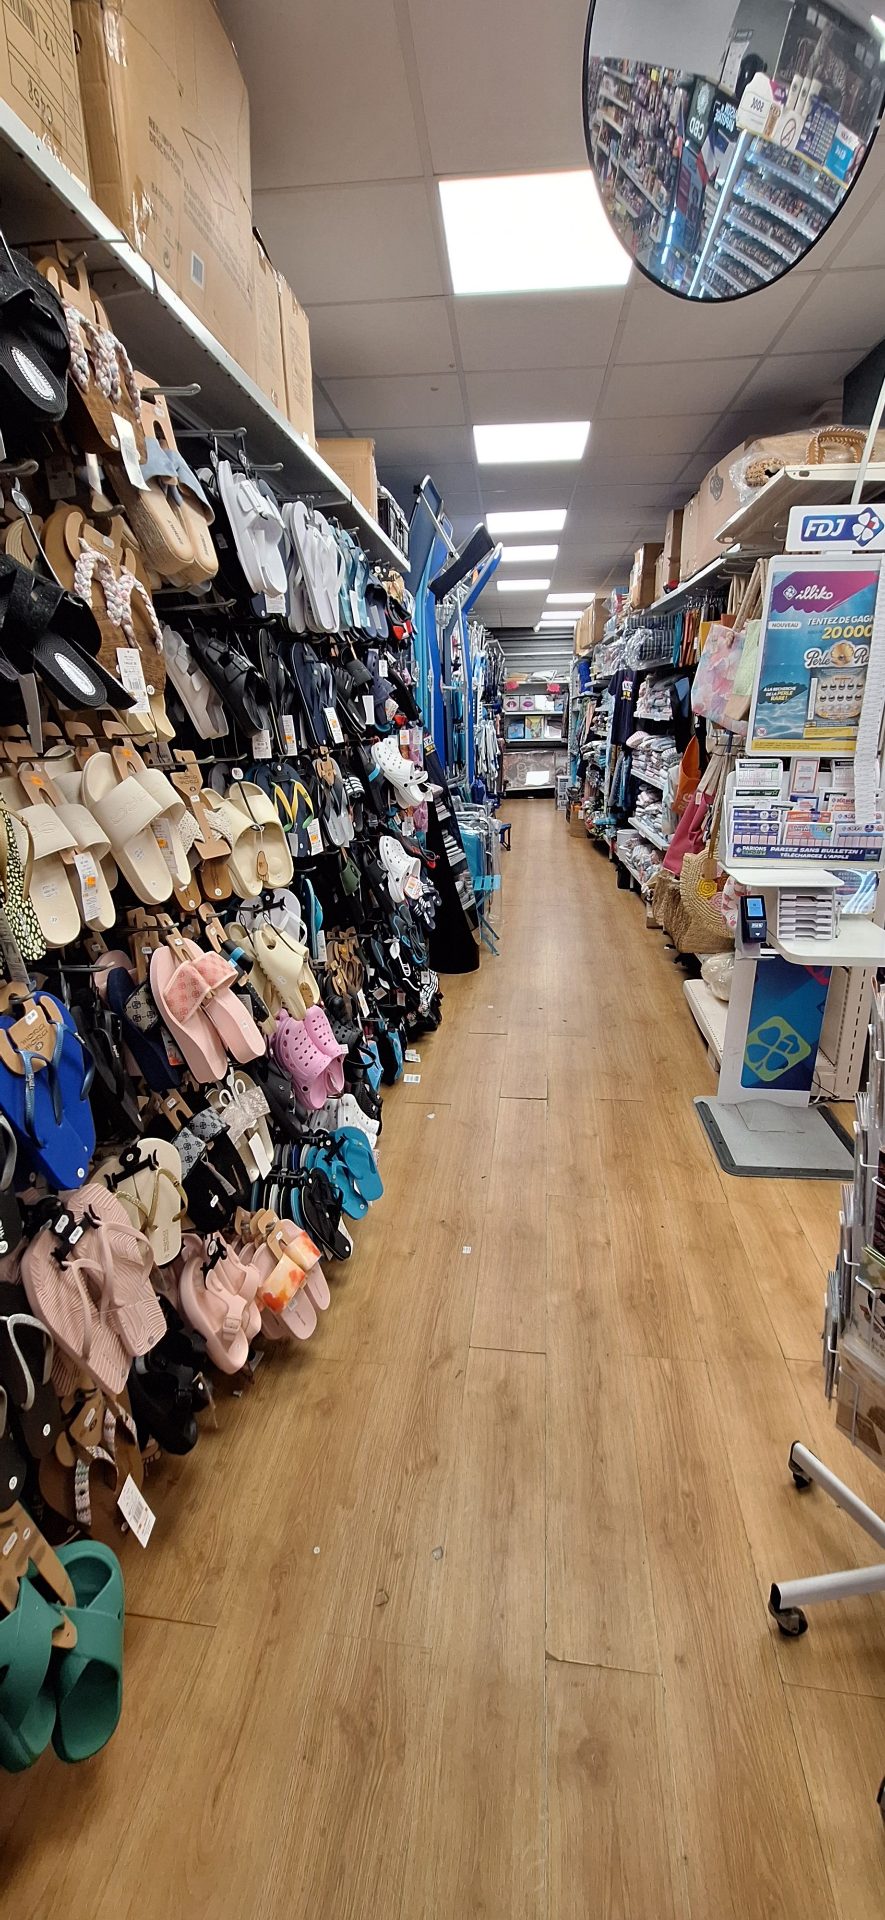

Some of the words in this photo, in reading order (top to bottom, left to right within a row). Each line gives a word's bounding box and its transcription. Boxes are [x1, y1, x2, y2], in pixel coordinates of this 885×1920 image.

[804, 518, 846, 538] FDJ
[795, 585, 834, 600] illiko
[808, 617, 838, 626] TENTEZ
[838, 616, 850, 624] DE
[806, 650, 831, 667] Perle
